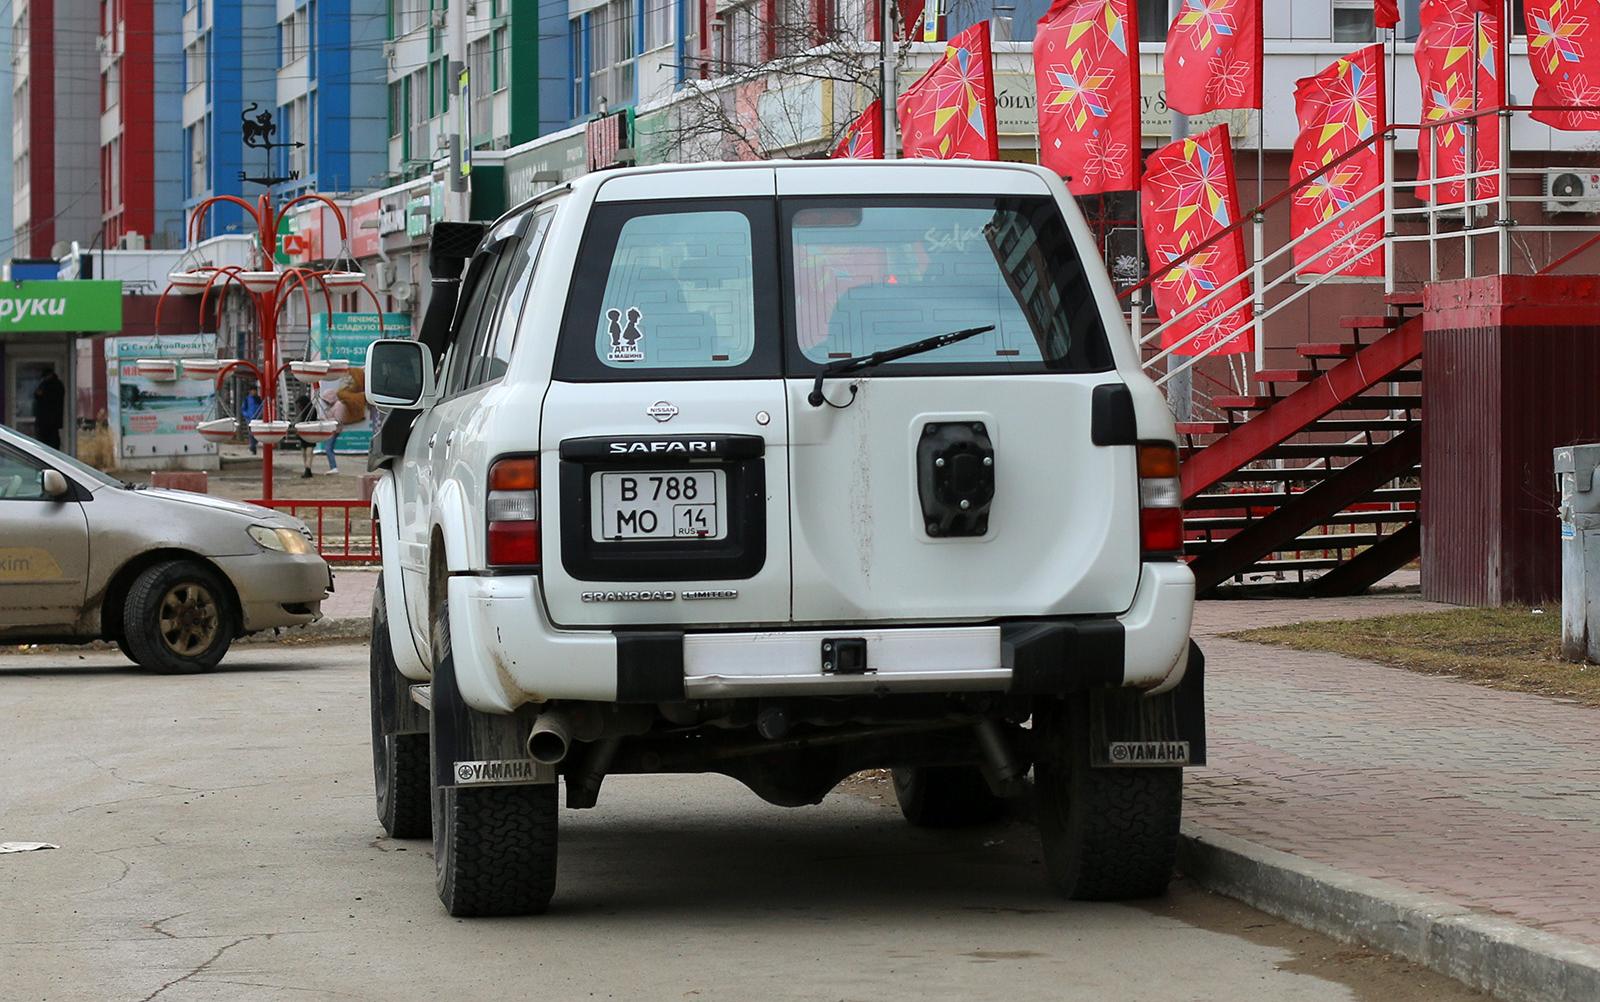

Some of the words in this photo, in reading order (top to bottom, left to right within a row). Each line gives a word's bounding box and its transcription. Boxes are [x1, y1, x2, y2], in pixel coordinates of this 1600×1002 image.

[1154, 90, 1168, 114] S
[610, 441, 716, 454] SAFARI
[649, 476, 698, 500] 788
[683, 508, 706, 527] 14
[678, 527, 696, 535] RUS
[581, 591, 676, 602] GRANROAD
[683, 589, 738, 600] LIMITED
[1128, 744, 1186, 760] YAMAHA
[473, 763, 532, 779] YAMAHA
